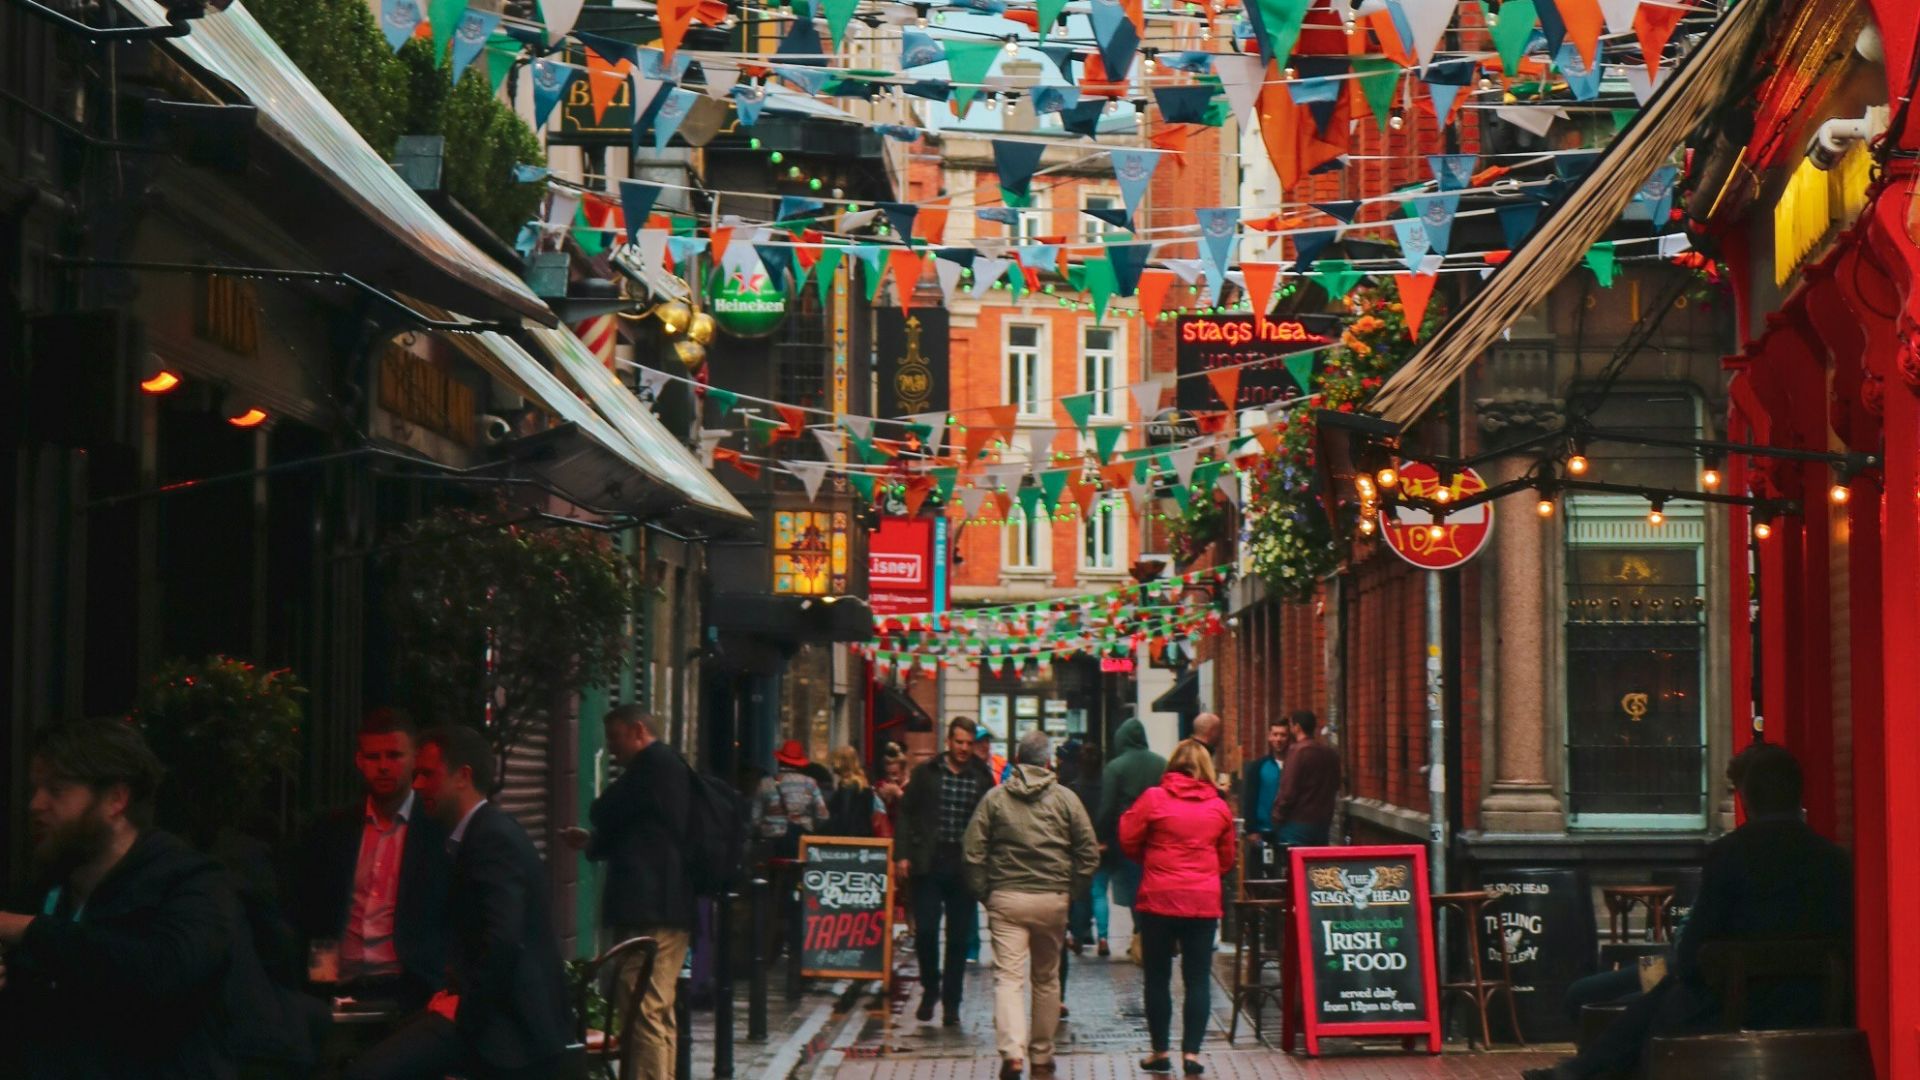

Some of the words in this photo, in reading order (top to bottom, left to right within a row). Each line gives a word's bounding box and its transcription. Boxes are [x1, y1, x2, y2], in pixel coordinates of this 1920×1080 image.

[714, 298, 785, 312] Heineken
[1183, 319, 1252, 346] stags
[935, 522, 946, 541] FOR
[935, 544, 946, 567] SALE
[869, 557, 917, 578] isney
[804, 870, 887, 892] OPEN
[1347, 874, 1370, 884] THE
[1522, 883, 1549, 894] HEAD
[820, 885, 881, 908] Lunch
[1311, 891, 1352, 905] STAG'S
[1372, 890, 1410, 902] HEAD
[804, 910, 886, 951] TAPAS
[1322, 920, 1383, 955] IRISH
[1341, 952, 1407, 971] FOOD
[1340, 988, 1372, 998] served
[1373, 987, 1397, 999] daily
[1324, 1001, 1348, 1011] from
[1351, 1001, 1379, 1013] 12pm
[1380, 1002, 1391, 1010] to
